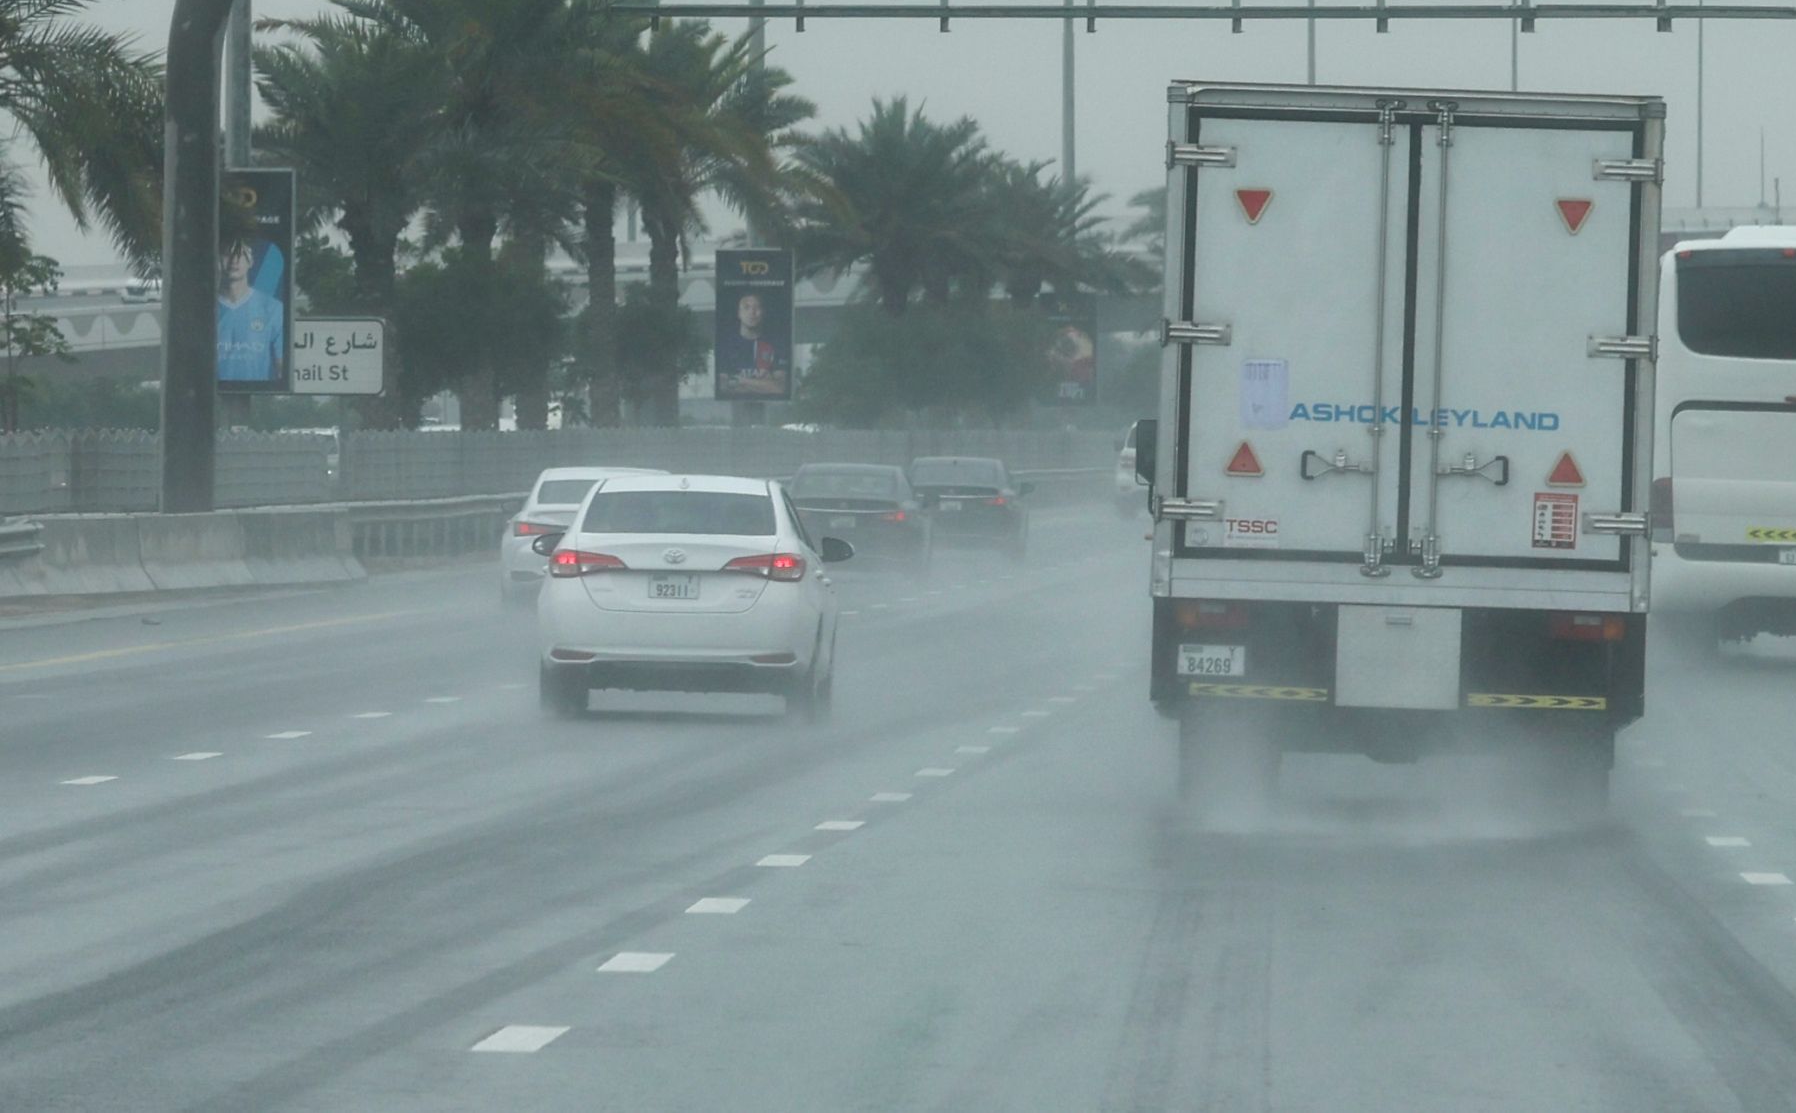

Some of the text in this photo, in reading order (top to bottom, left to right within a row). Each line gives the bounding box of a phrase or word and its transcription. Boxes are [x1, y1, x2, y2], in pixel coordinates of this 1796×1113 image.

[325, 332, 378, 357] شارع
[328, 365, 349, 381] St
[1289, 402, 1560, 432] ASHOK LEYLAND
[1226, 519, 1277, 534] TSSC
[1187, 656, 1232, 674] 84269
